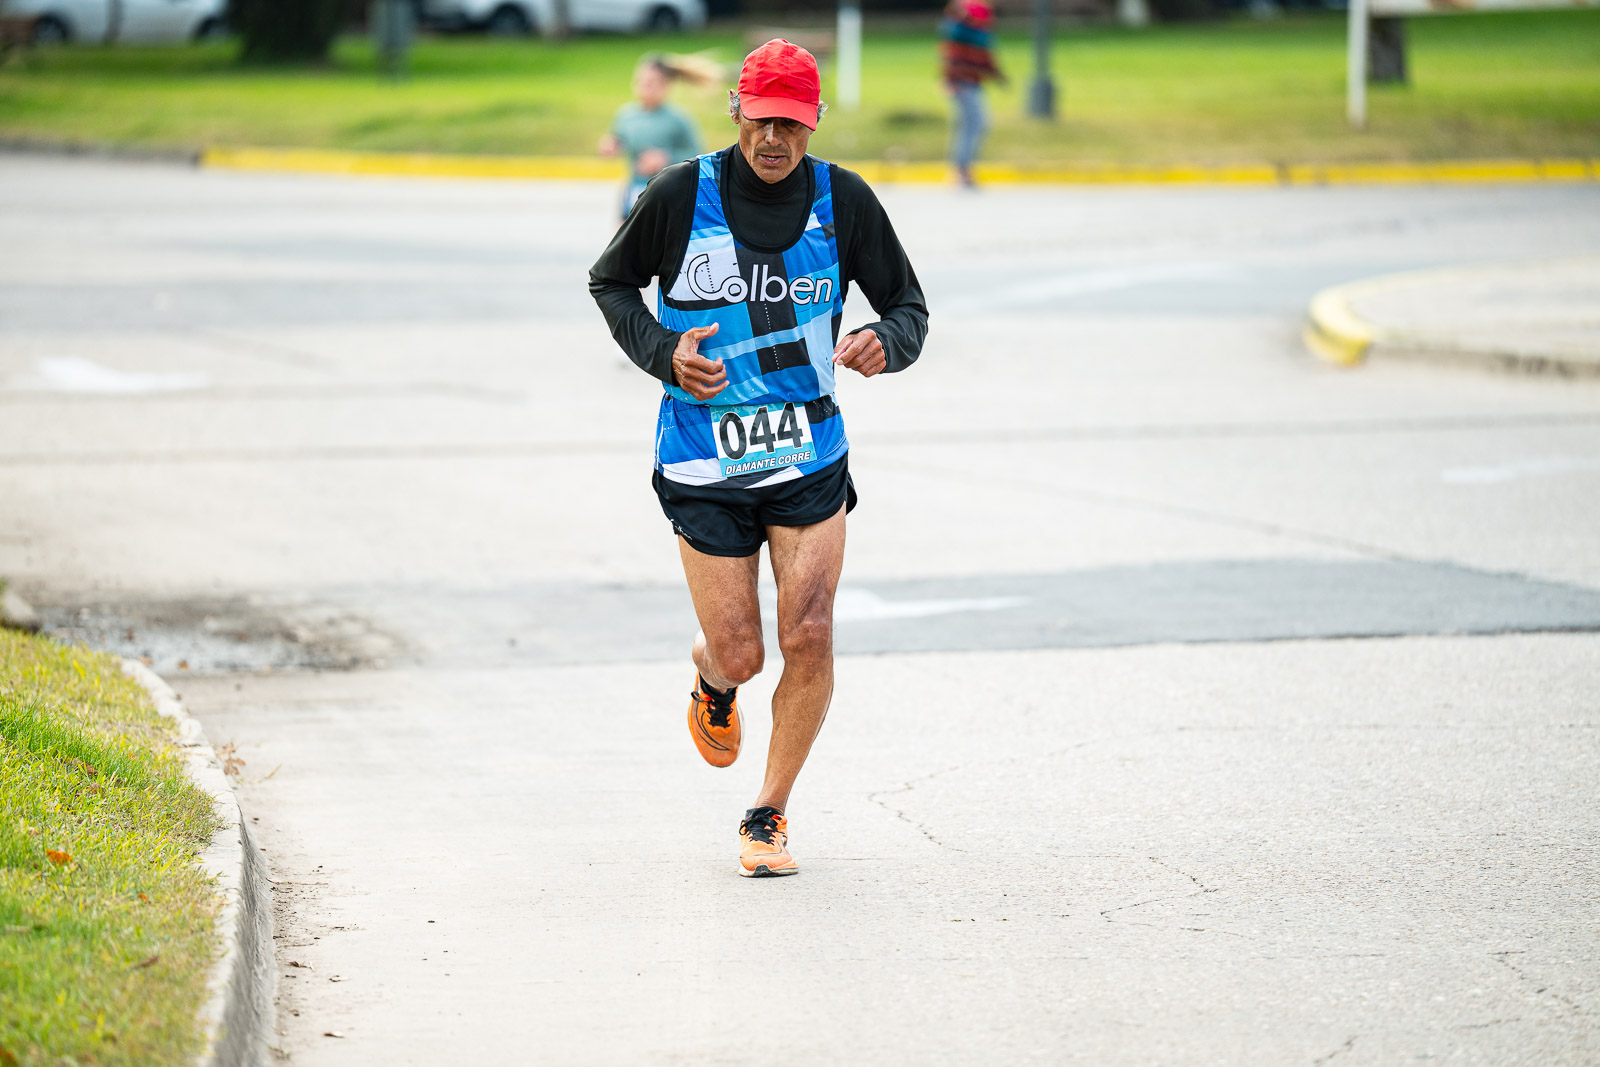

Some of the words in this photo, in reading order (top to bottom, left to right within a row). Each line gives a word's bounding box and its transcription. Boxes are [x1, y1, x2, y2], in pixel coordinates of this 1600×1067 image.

[687, 253, 833, 305] Colben
[719, 402, 803, 461] 044
[725, 458, 776, 475] DIAMANTE
[777, 451, 811, 465] CORRE
